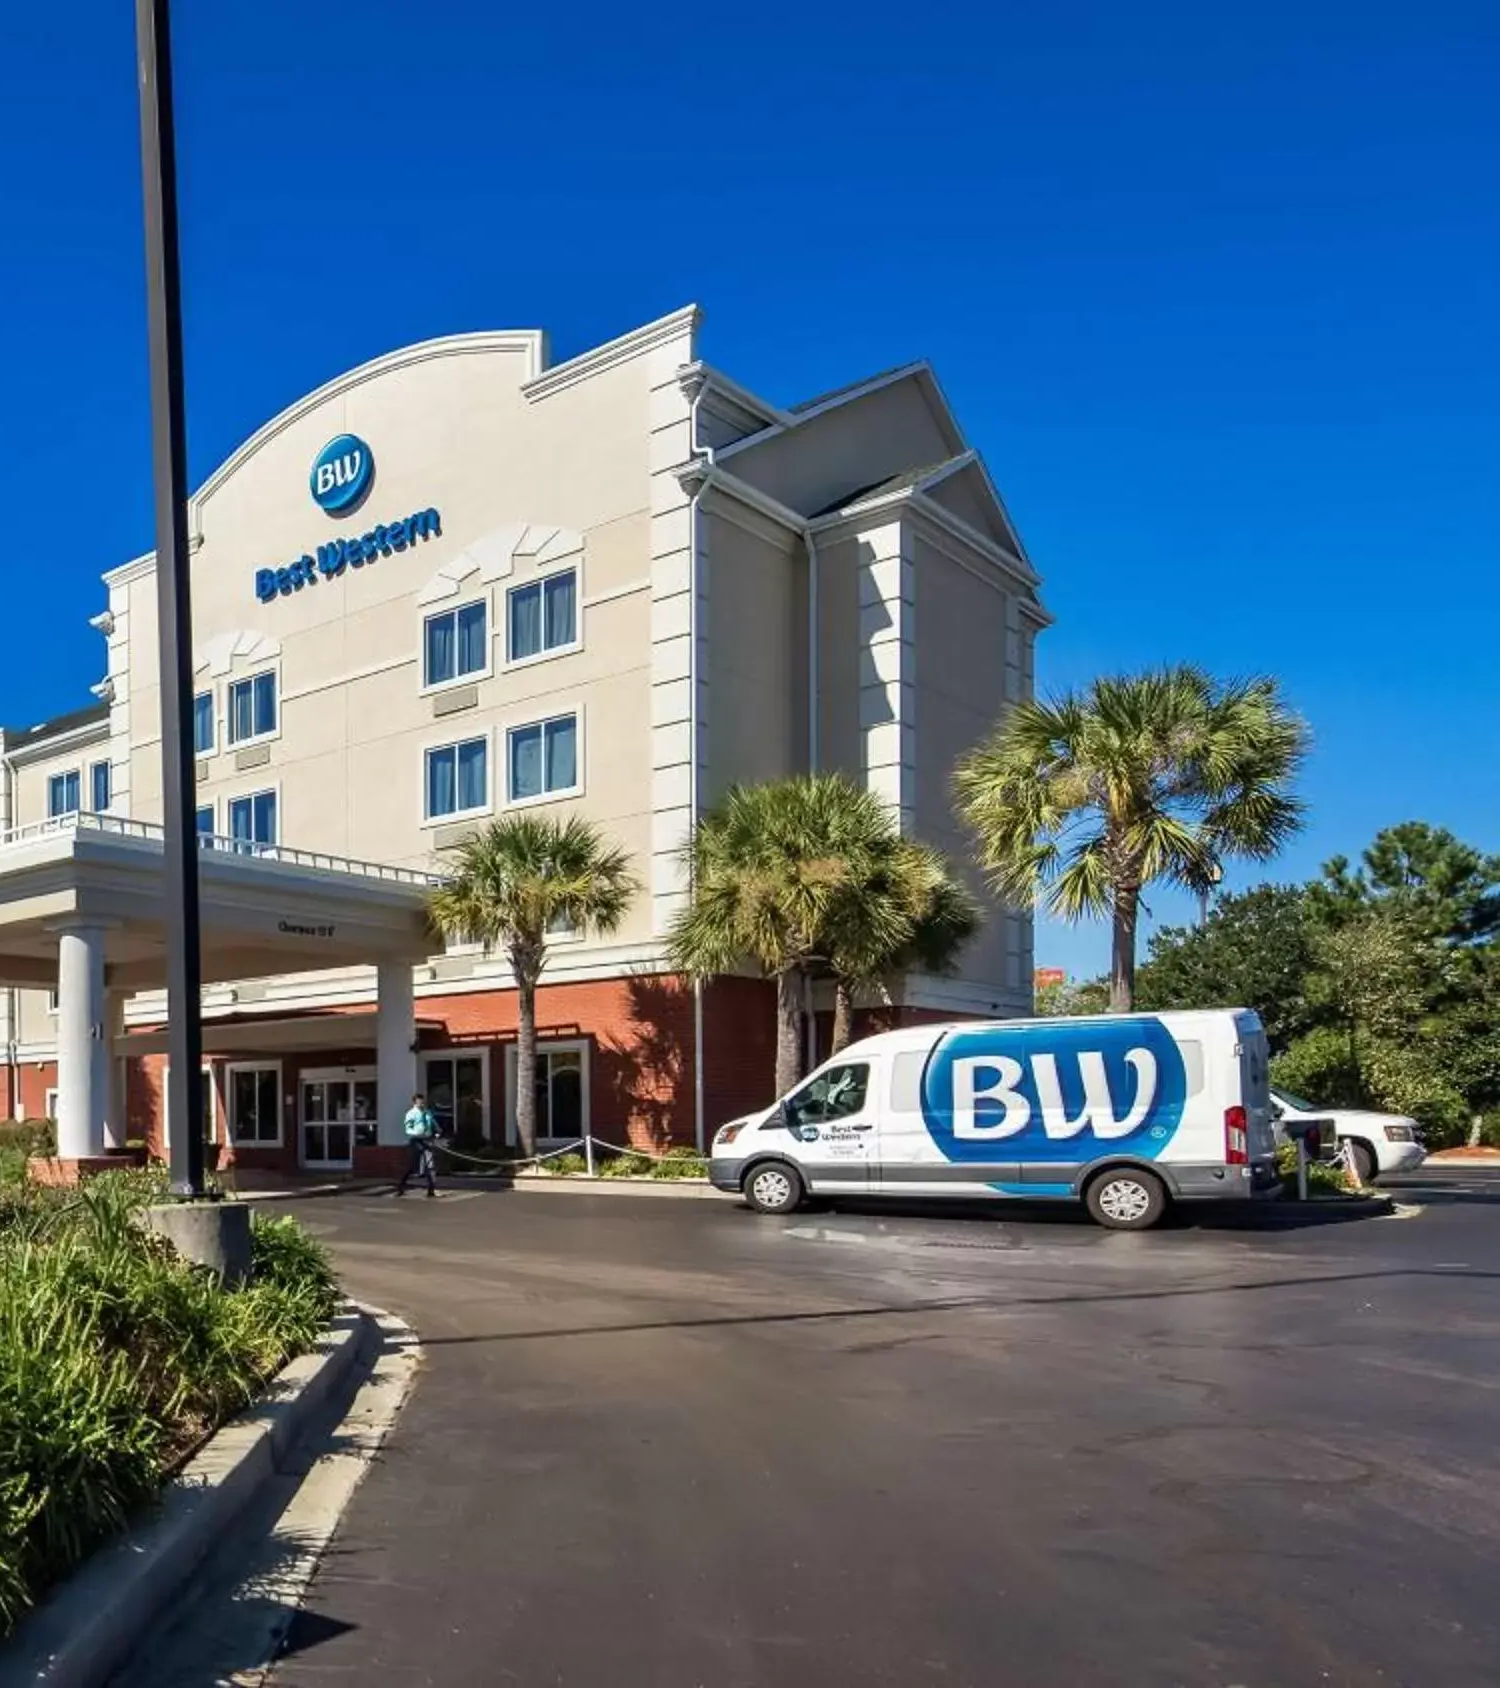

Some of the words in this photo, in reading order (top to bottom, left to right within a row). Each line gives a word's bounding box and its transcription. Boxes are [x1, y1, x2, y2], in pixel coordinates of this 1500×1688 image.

[317, 450, 360, 495] BW
[256, 555, 317, 602] Best
[317, 508, 442, 579] Western
[952, 1047, 1157, 1140] BW
